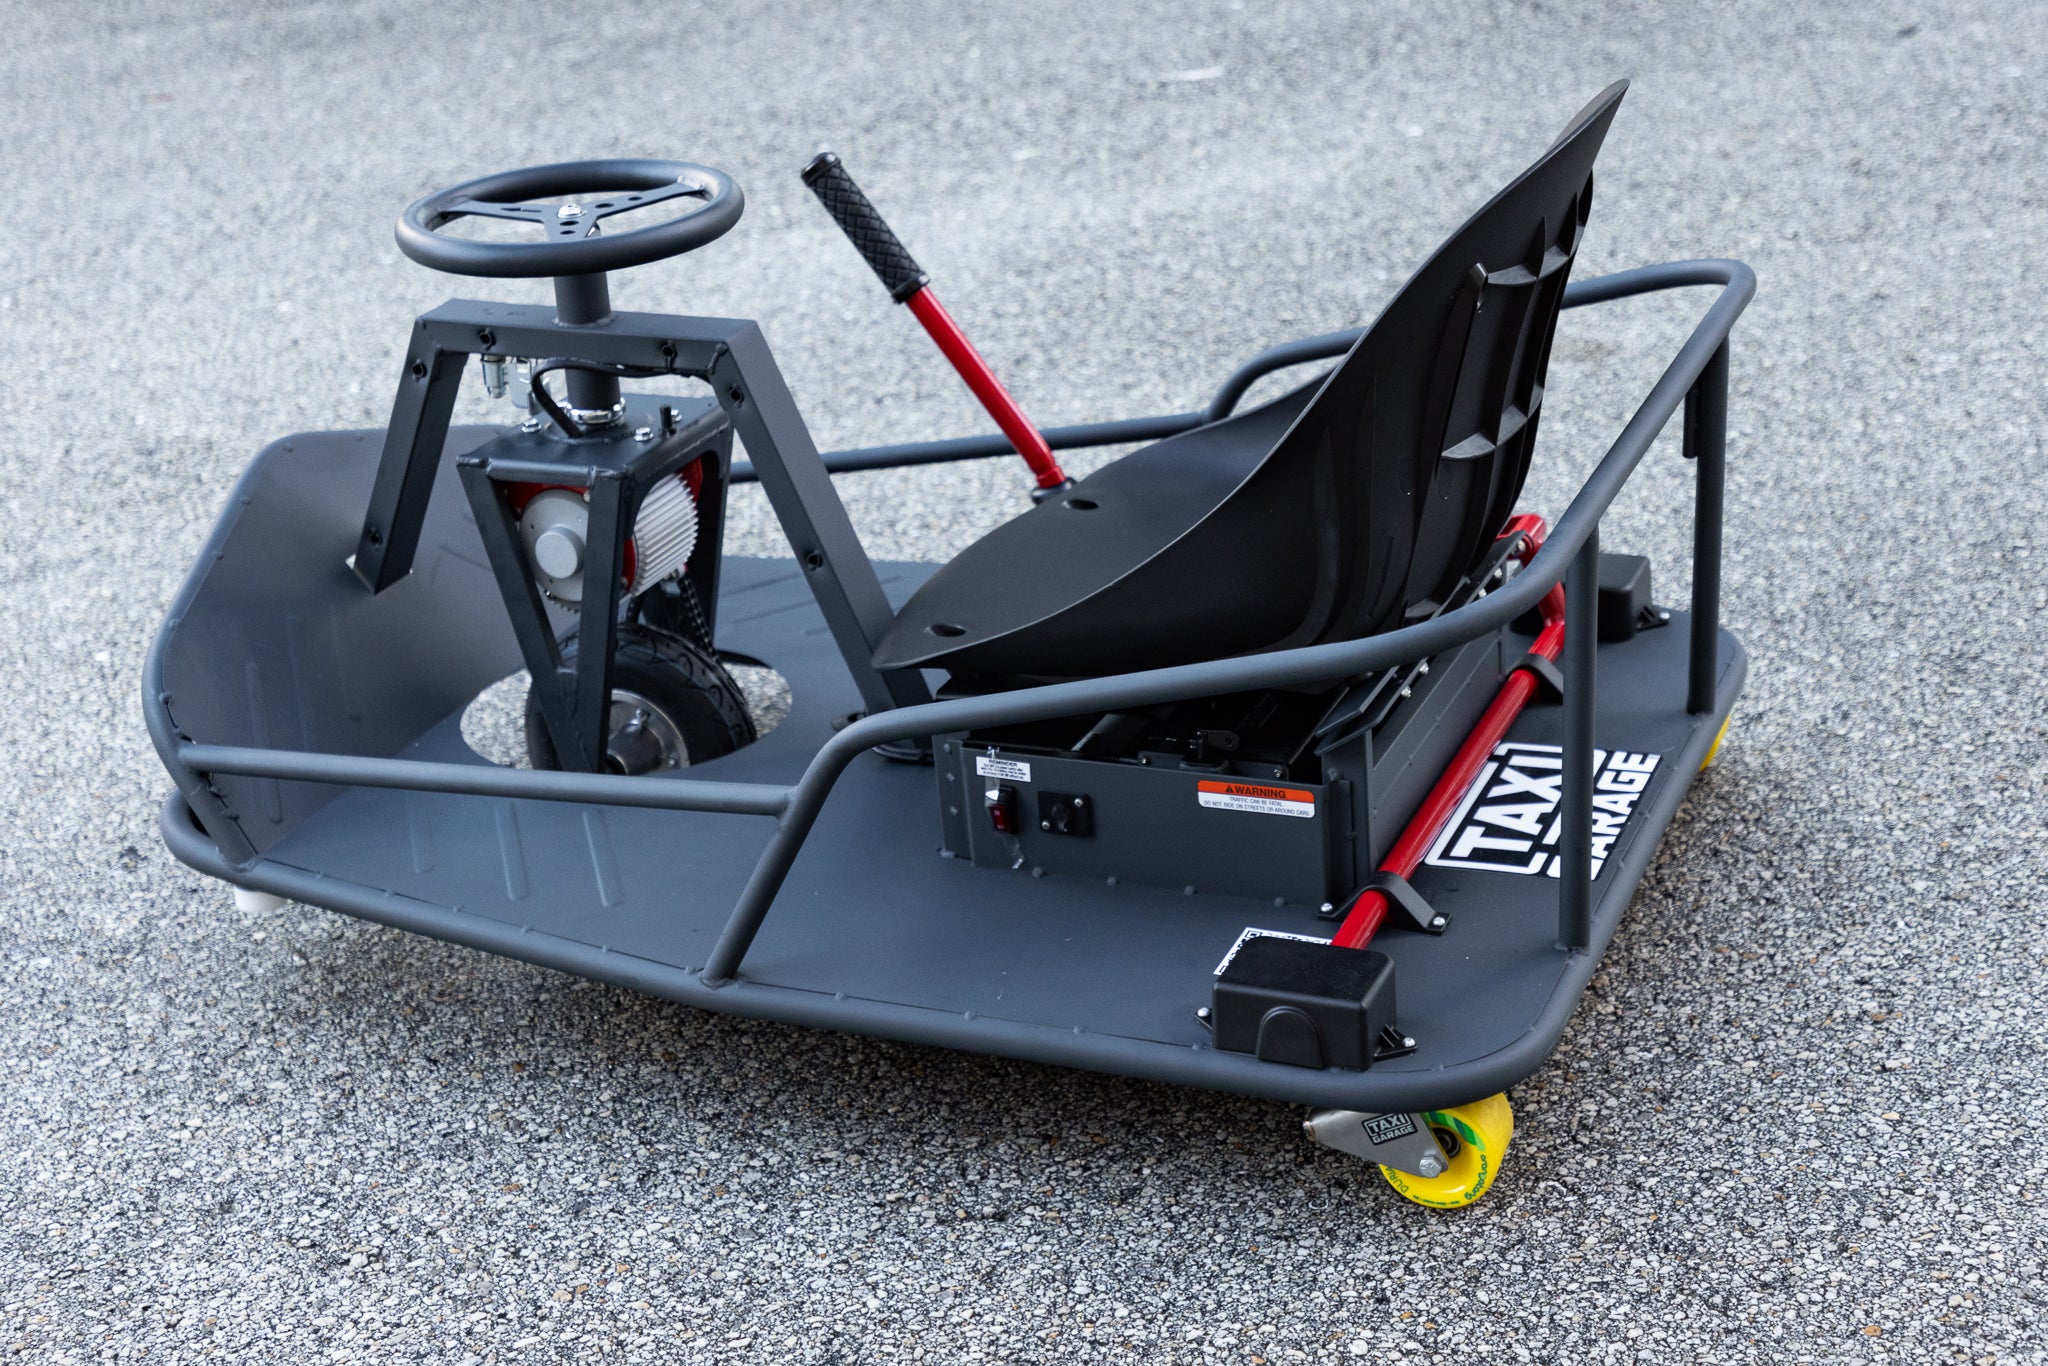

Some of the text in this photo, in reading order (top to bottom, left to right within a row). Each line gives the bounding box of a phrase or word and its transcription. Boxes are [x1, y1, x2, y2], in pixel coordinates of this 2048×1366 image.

[988, 759, 1018, 768] REMINDER
[1234, 785, 1287, 799] WARNING
[1229, 796, 1248, 804] TRAFFIC
[1449, 754, 1563, 858] TAXI
[1274, 807, 1296, 815] AROUND
[1368, 1113, 1407, 1133] TAXI
[1372, 1124, 1415, 1144] GARAGE
